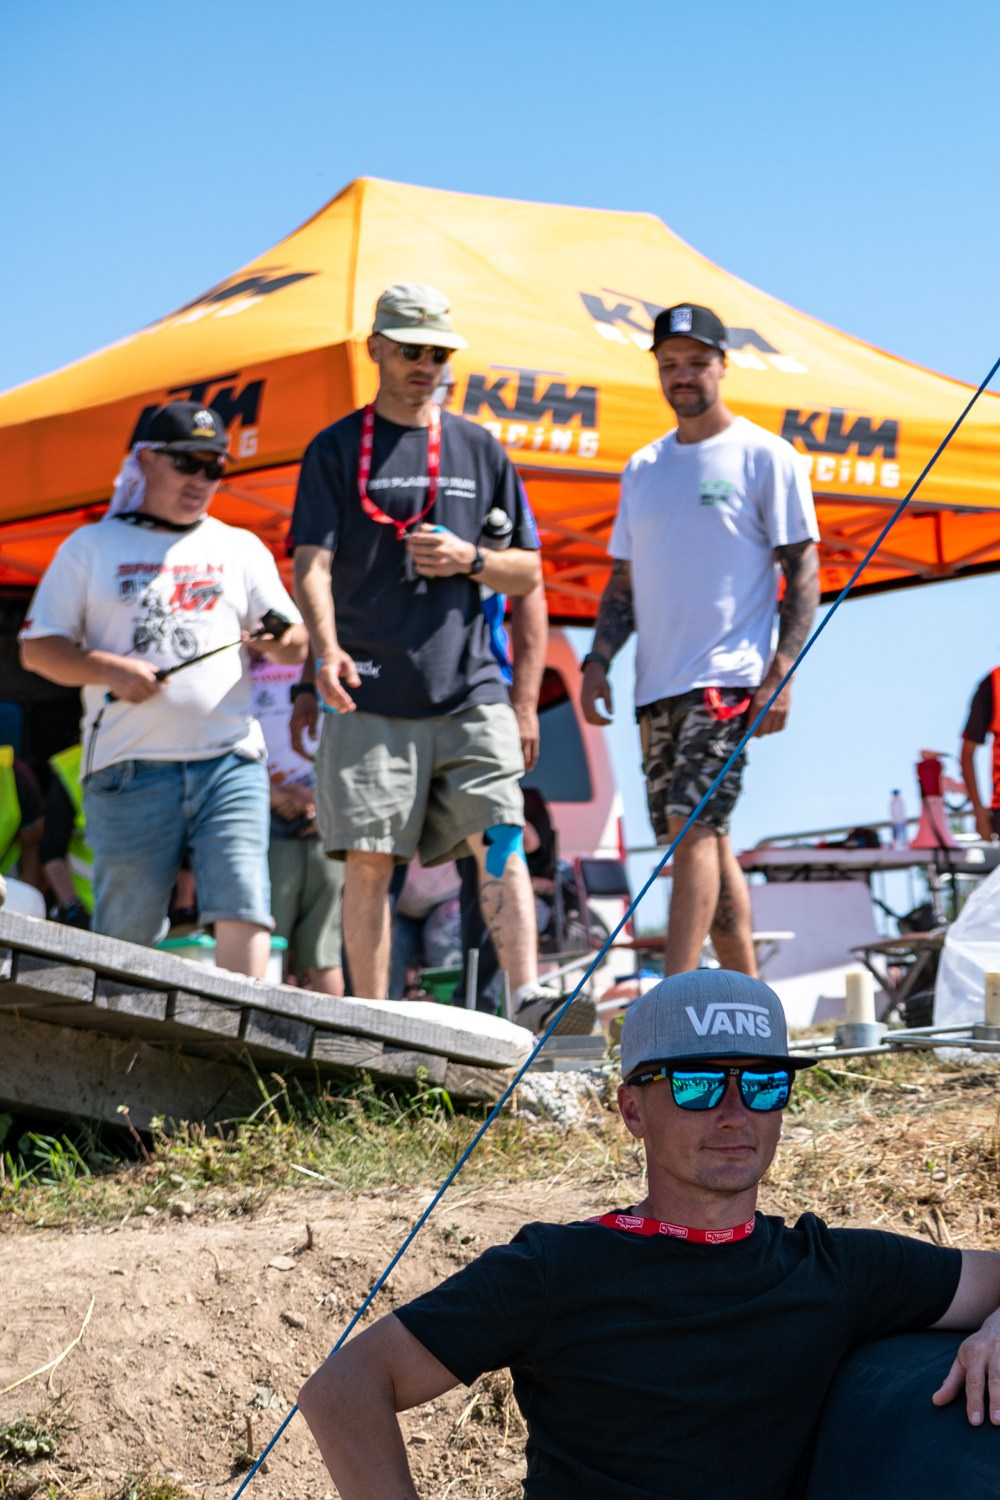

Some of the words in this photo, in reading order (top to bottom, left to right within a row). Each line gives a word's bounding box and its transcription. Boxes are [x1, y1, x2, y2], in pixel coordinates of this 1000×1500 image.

[462, 364, 598, 428] KTM
[780, 403, 899, 460] KTM
[685, 1002, 772, 1039] VANS
